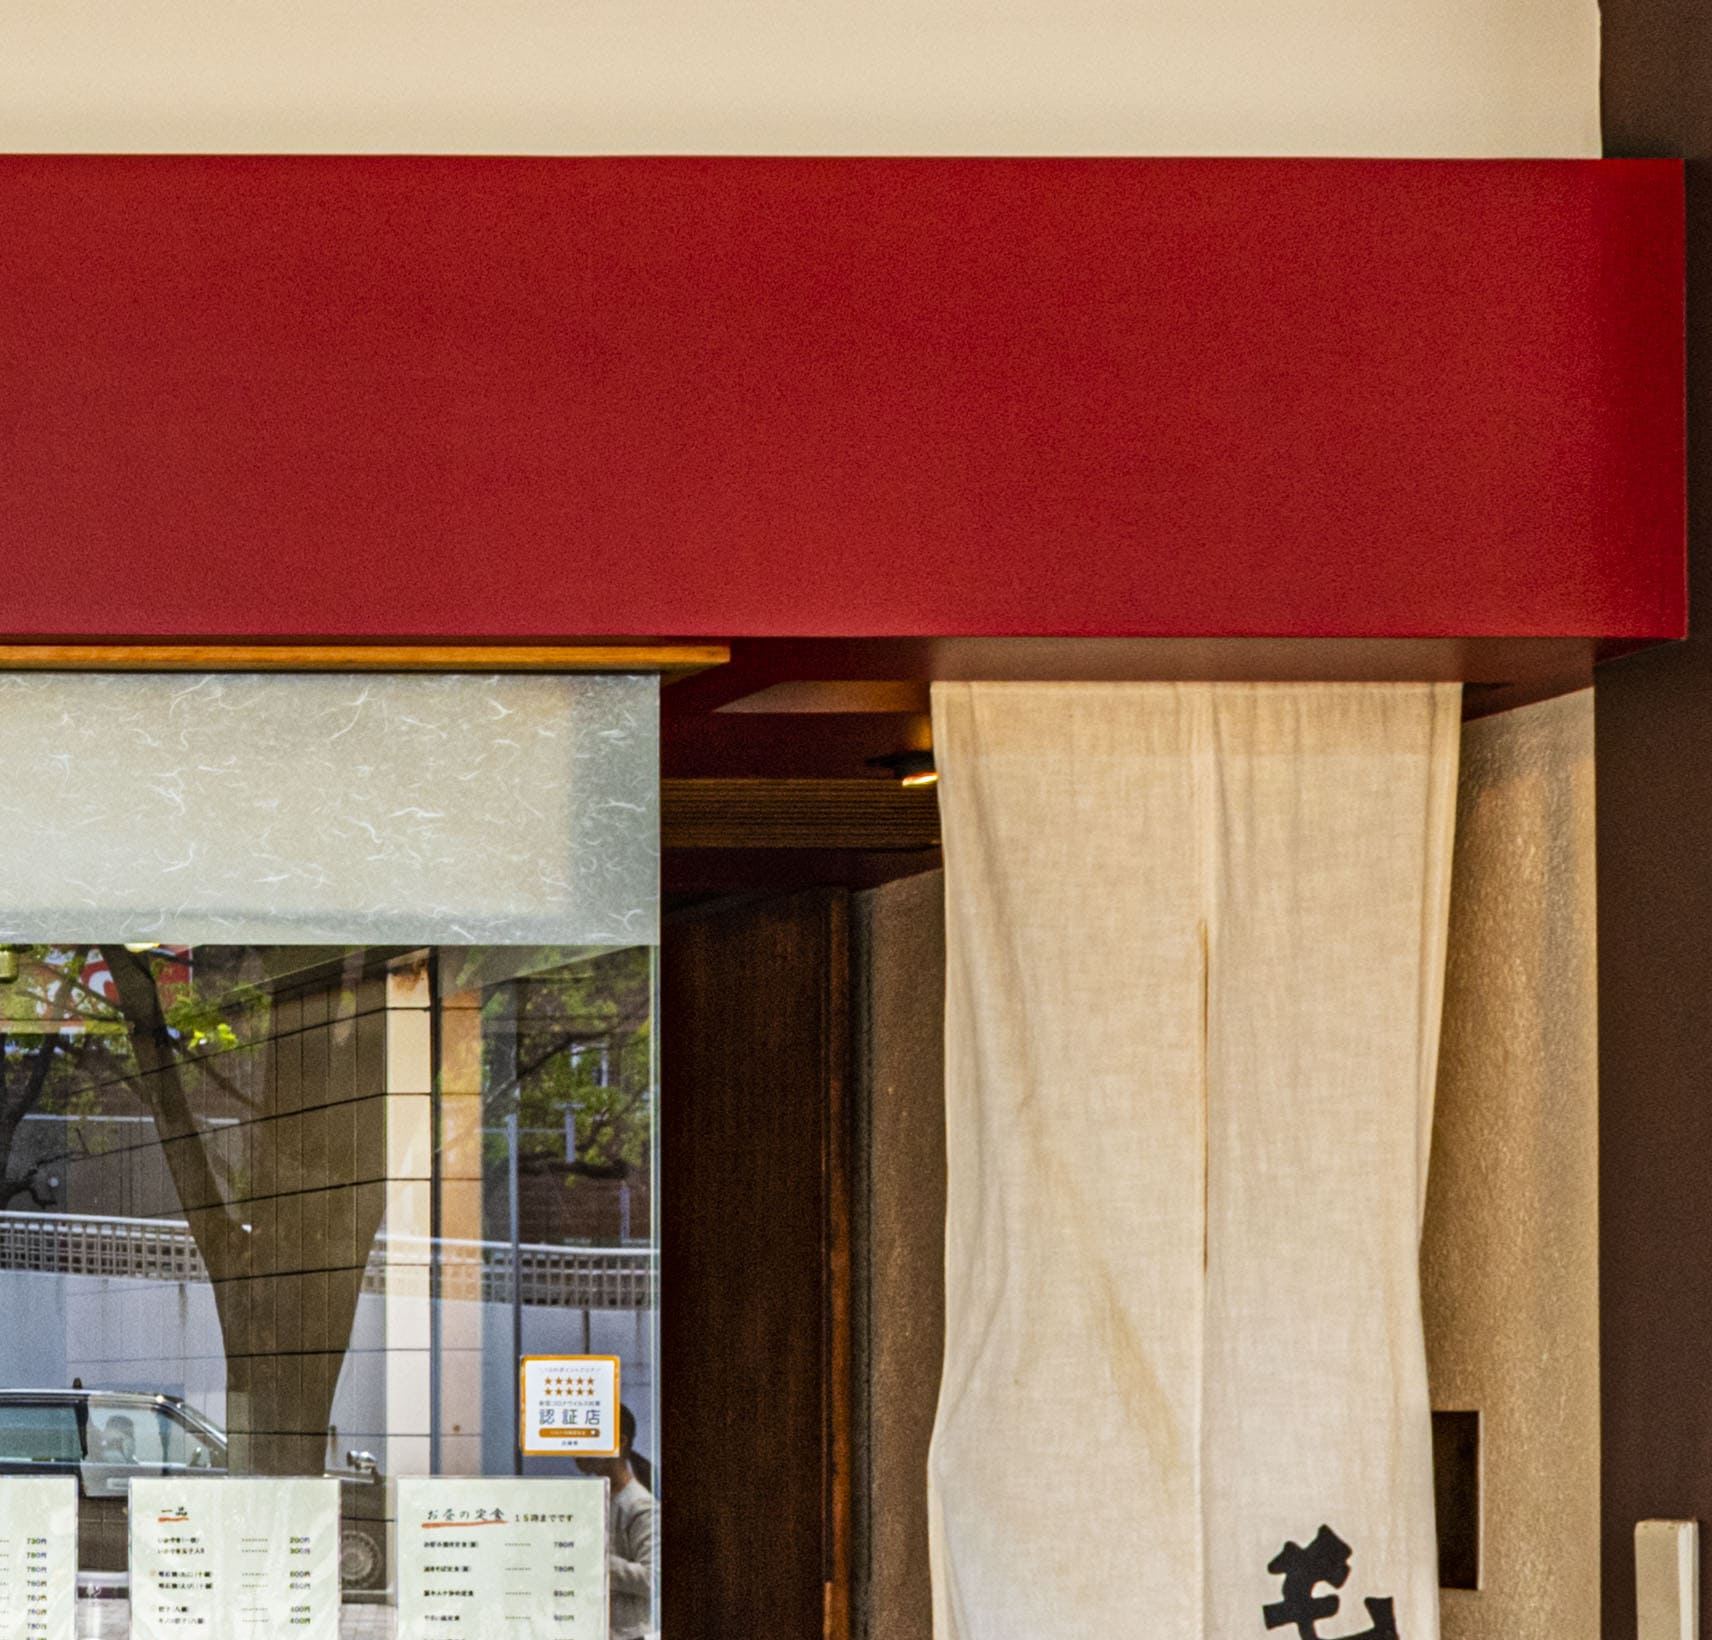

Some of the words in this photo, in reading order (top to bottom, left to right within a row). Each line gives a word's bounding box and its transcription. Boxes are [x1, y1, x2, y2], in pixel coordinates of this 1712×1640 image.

[539, 1408, 601, 1426] 認証店
[161, 1507, 187, 1516] 一品
[426, 1509, 505, 1520] お昼の定食
